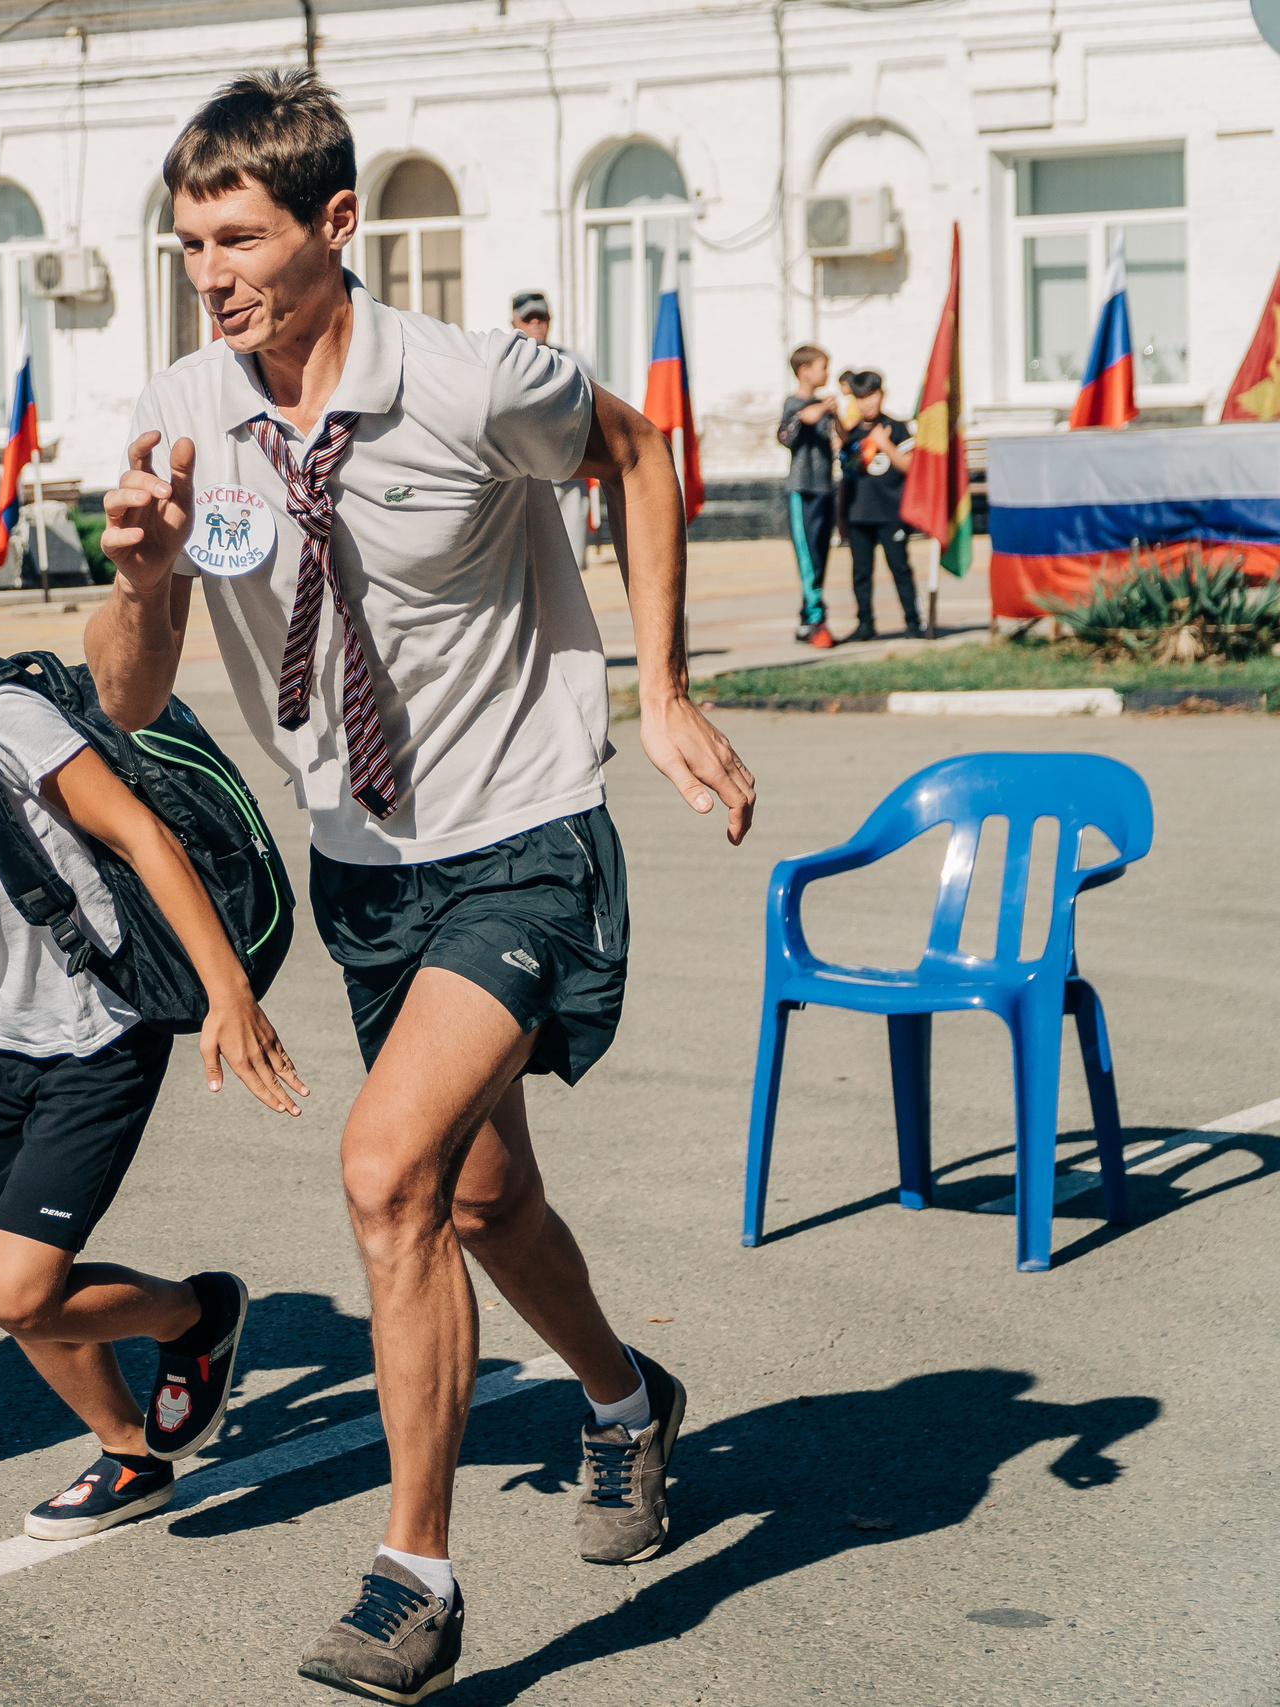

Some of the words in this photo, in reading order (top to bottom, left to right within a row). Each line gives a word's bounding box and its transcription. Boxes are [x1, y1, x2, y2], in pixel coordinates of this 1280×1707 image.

[195, 488, 265, 508] «УСПЕХ»
[189, 544, 225, 568] СОШ
[511, 948, 540, 972] NIKE
[40, 1207, 72, 1219] DEMIX
